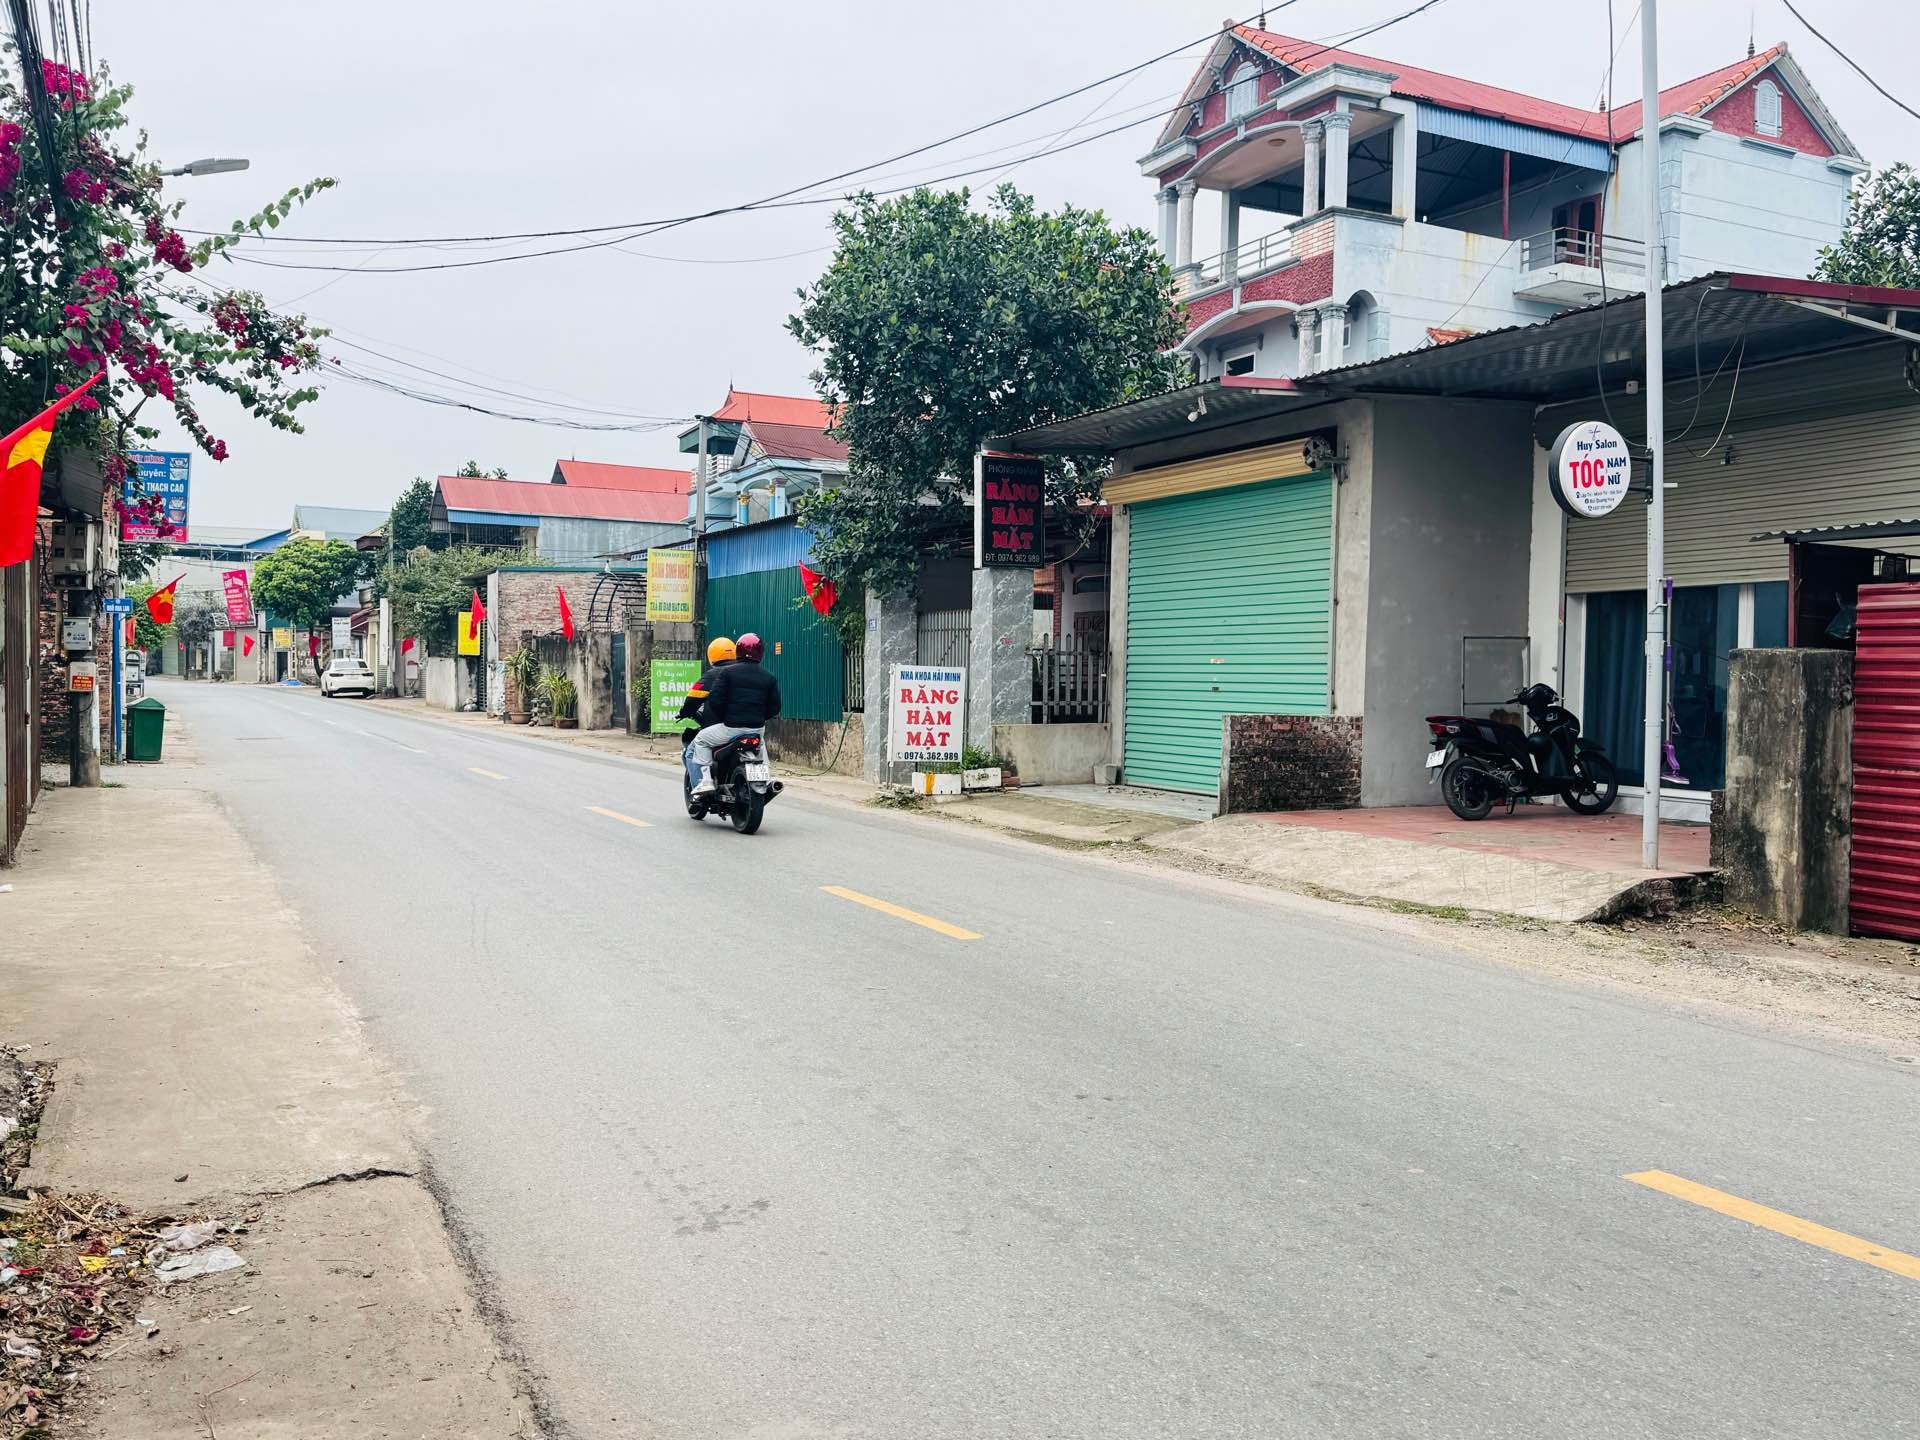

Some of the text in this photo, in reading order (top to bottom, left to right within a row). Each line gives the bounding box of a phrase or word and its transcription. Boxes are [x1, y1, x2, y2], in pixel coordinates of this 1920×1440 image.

[1577, 440, 1617, 451] Huy Salon
[1607, 457, 1626, 468] NAM
[1569, 453, 1605, 489] TÓC
[170, 483, 184, 493] CAO
[985, 478, 1040, 502] RĂNG
[992, 526, 1034, 552] MẶT
[998, 554, 1013, 562] 0974
[1015, 554, 1026, 562] 362
[901, 671, 913, 681] NHA
[915, 672, 931, 681] KHOA
[945, 673, 961, 682] MINH
[659, 679, 692, 692] BÁNH
[901, 684, 959, 705] RĂNG
[662, 696, 685, 707] SIN
[659, 710, 680, 721] NH
[907, 707, 952, 726] HÀM
[907, 728, 950, 750] MẶT
[904, 752, 959, 761] 0974.362.989
